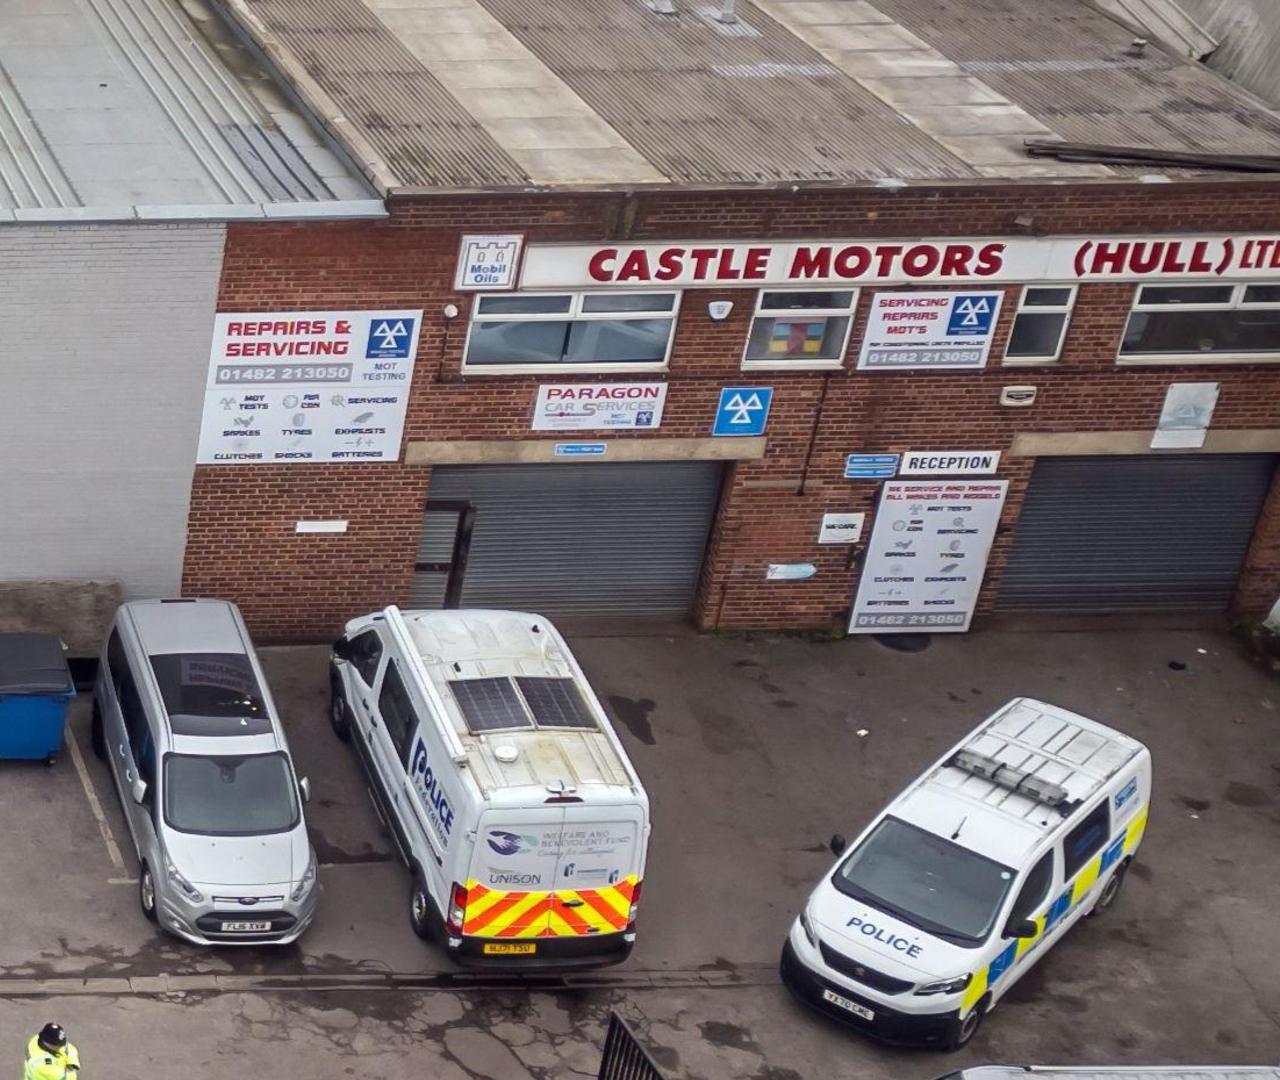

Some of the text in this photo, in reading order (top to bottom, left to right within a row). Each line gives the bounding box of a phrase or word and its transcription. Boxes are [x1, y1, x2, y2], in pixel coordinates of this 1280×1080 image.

[588, 248, 772, 282] CASTLE
[788, 243, 1007, 279] MOTORS
[1074, 238, 1234, 277] (HULL)
[470, 264, 506, 274] Mobil
[473, 274, 499, 284] Oils
[879, 298, 949, 308] SERVICING
[882, 312, 938, 321] REPAIRS
[226, 320, 352, 337] REPAIRS &
[886, 325, 928, 335] MOT'S
[225, 341, 349, 357] SERVICING
[869, 351, 980, 363] 01482 213050
[374, 362, 398, 370] MOT
[219, 367, 349, 381] 01482 213050
[362, 373, 406, 381] TESTING
[547, 387, 660, 400] PARAGON
[347, 396, 397, 404] SERVICING
[545, 401, 656, 416] CAR SERVICES
[908, 456, 992, 470] RECEPTION
[858, 613, 965, 625] 01482 213050
[411, 736, 454, 835] POLICE
[542, 830, 610, 839] WELFARE AND
[541, 838, 602, 848] BENEVOLENT
[489, 874, 542, 884] UNISON
[846, 917, 923, 959] POLICE
